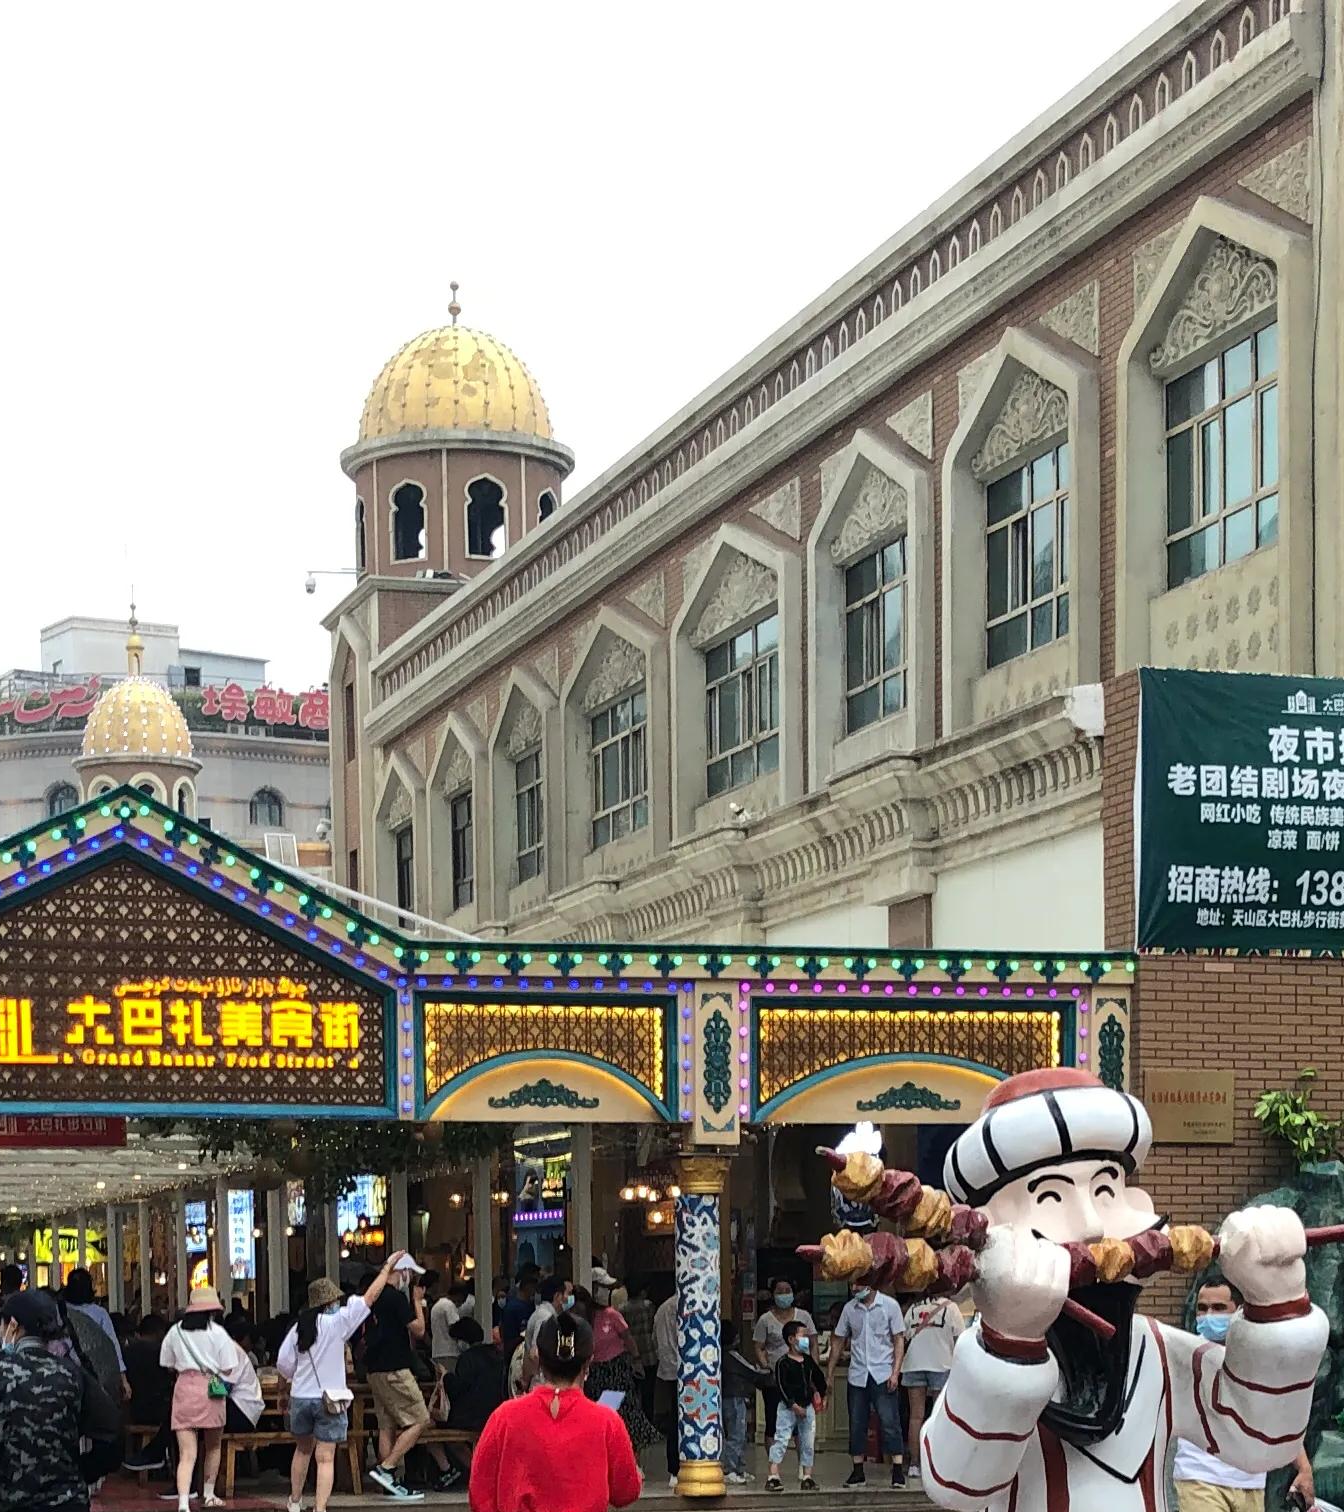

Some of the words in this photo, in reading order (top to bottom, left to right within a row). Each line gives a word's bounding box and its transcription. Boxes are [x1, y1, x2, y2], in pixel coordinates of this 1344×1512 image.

[1200, 802, 1262, 825] 网红小吃
[1267, 829, 1298, 851] 凉菜
[1167, 864, 1279, 905] 招商热线：
[65, 994, 360, 1049] 大巴扎美食街
[82, 1049, 143, 1067] Grand
[149, 1051, 215, 1068] Bazaar
[225, 1052, 270, 1069] Food
[276, 1052, 334, 1069] Street
